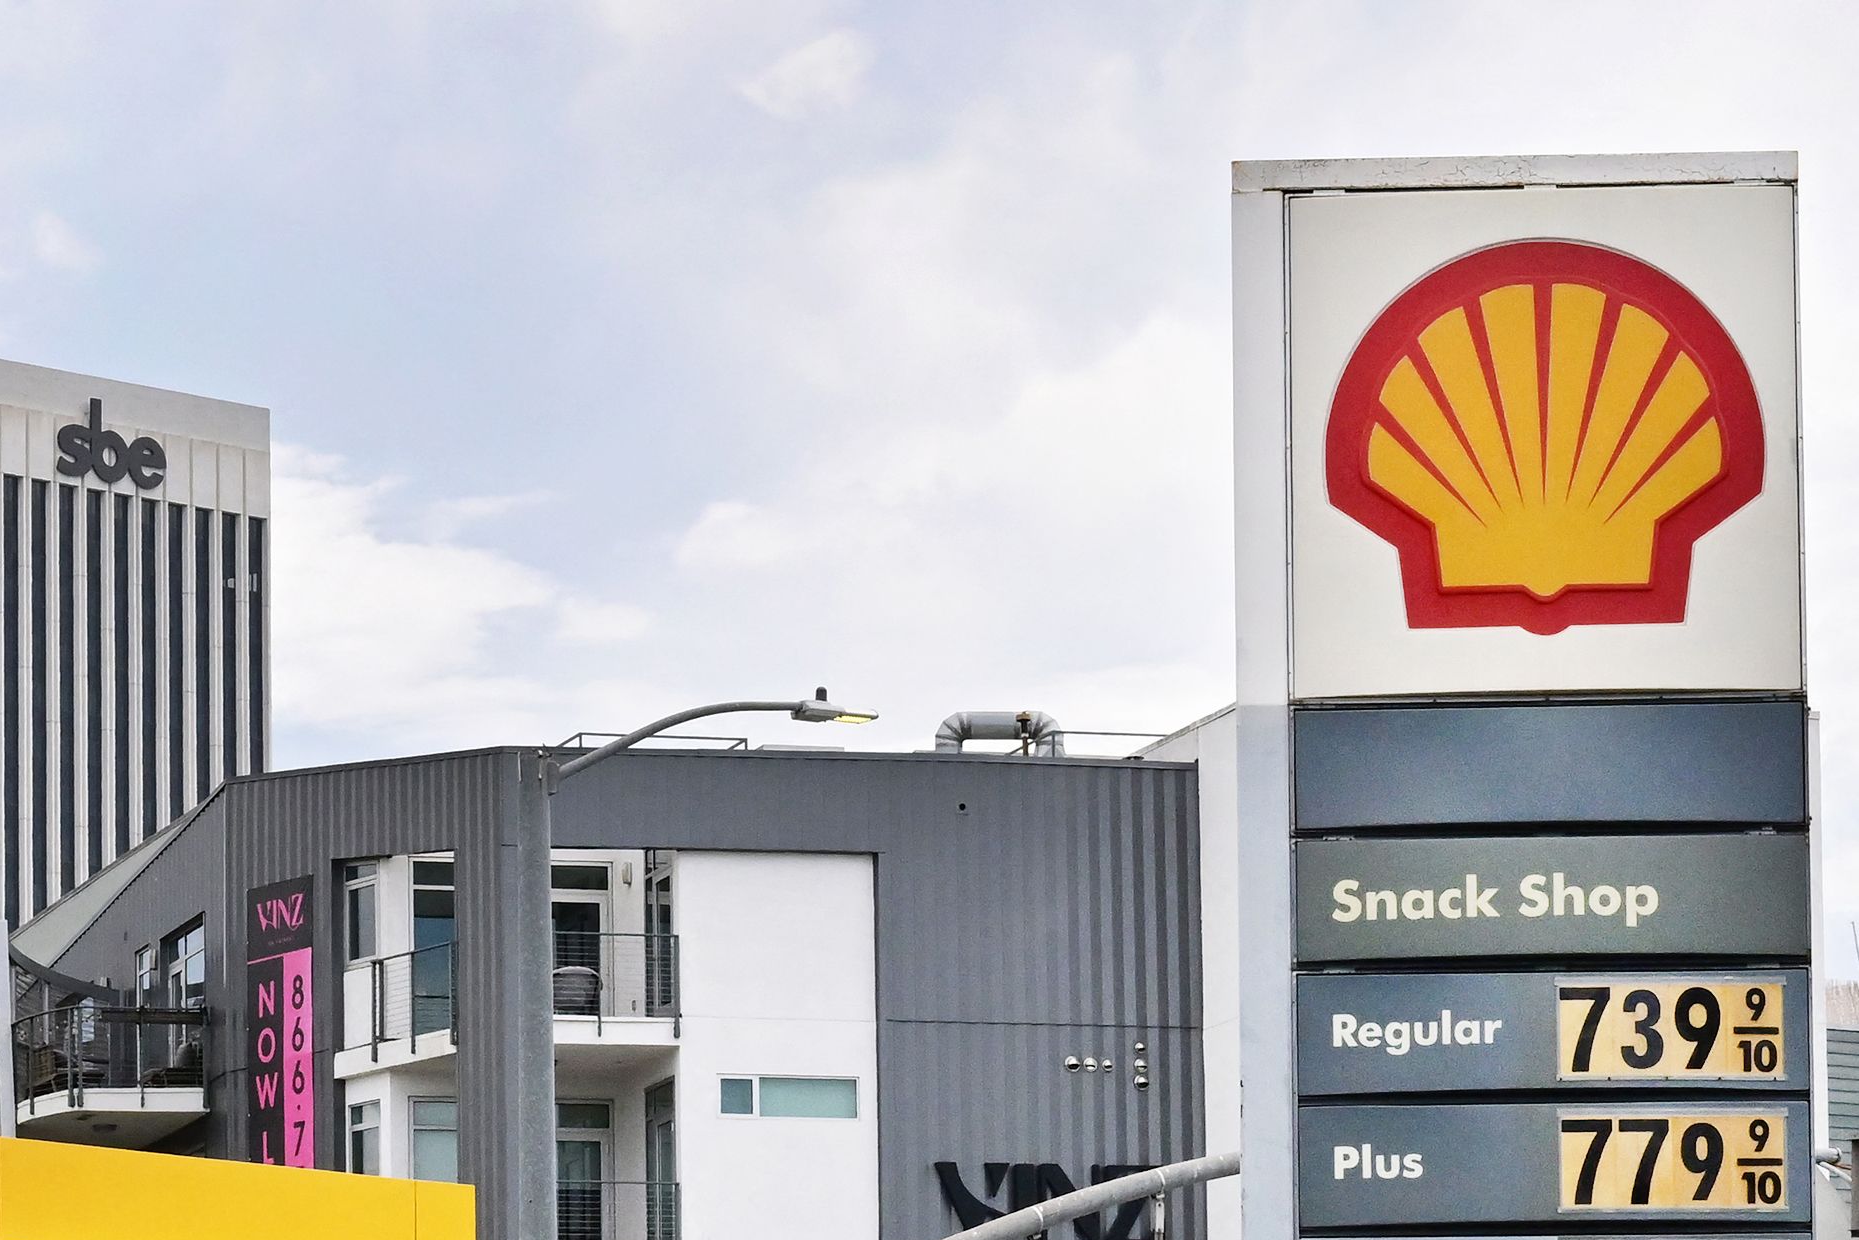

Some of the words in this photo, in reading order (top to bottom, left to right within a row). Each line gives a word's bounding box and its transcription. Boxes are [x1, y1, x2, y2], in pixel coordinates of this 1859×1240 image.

[56, 397, 167, 490] sbe
[1332, 874, 1500, 922] Snack
[1518, 873, 1660, 927] Shop
[1745, 987, 1767, 1021] 9
[255, 979, 279, 1111] NOW
[1332, 1010, 1502, 1055] Regular
[1559, 986, 1722, 1073] 739
[1737, 1040, 1778, 1073] 10
[1749, 1119, 1770, 1152] 9
[1333, 1144, 1424, 1180] Plus
[1561, 1118, 1724, 1205] 779
[1741, 1171, 1782, 1205] 10
